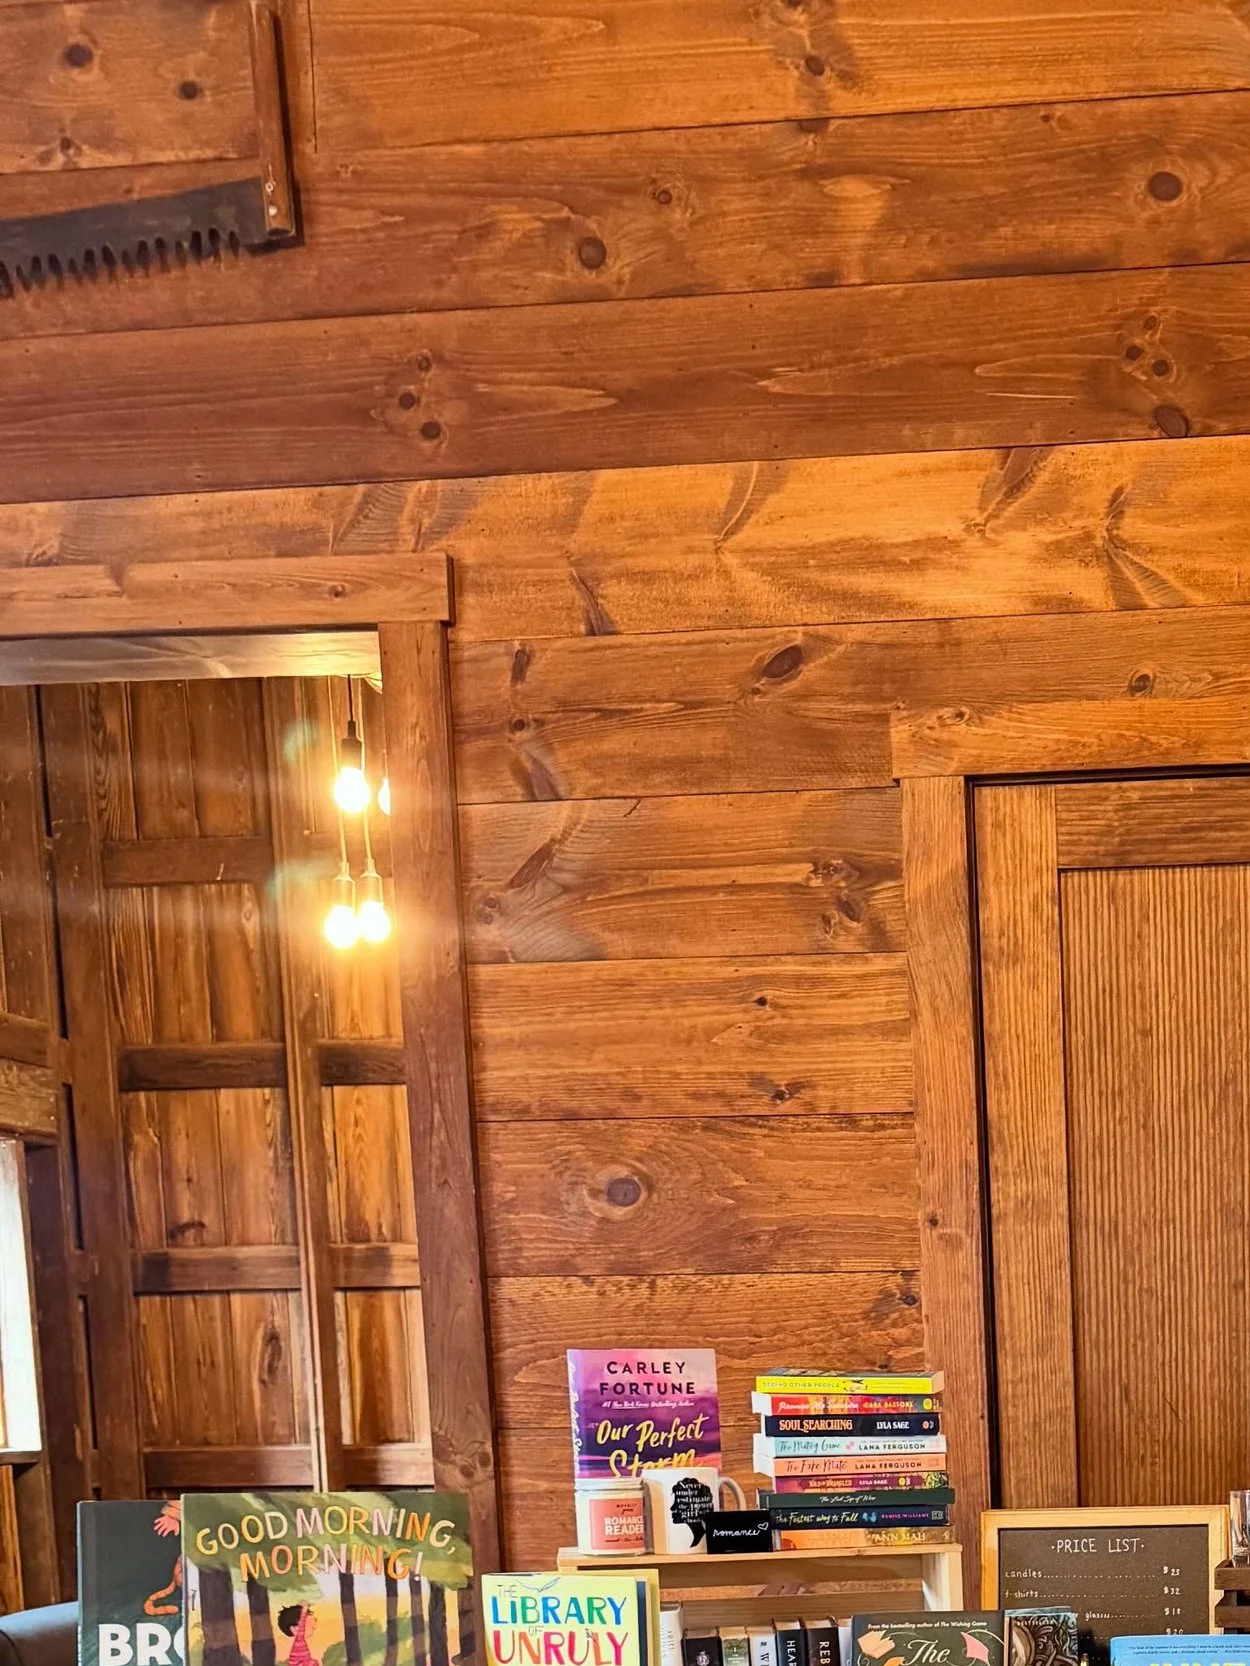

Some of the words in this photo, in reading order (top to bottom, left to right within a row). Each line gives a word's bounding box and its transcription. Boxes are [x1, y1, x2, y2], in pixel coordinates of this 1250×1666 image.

[607, 1361, 685, 1375] CARLEY
[600, 1382, 695, 1396] FORTUNE
[597, 1420, 633, 1444] Our
[636, 1413, 709, 1452] Perfect
[779, 1420, 801, 1431] SOUL
[801, 1419, 853, 1433] SEARCHING
[855, 1462, 876, 1470] LANA
[879, 1461, 922, 1469] FERGUSON
[195, 1510, 289, 1555] GOOD
[295, 1505, 457, 1555] MORNING,
[712, 1528, 760, 1538] romance
[1056, 1538, 1097, 1553] PRICE
[1108, 1538, 1140, 1553] LIST
[239, 1542, 424, 1583] MORNING!
[497, 1584, 517, 1599] THE
[528, 1625, 544, 1636] OF
[493, 1630, 629, 1666] UNRULY
[901, 1639, 951, 1664] The
